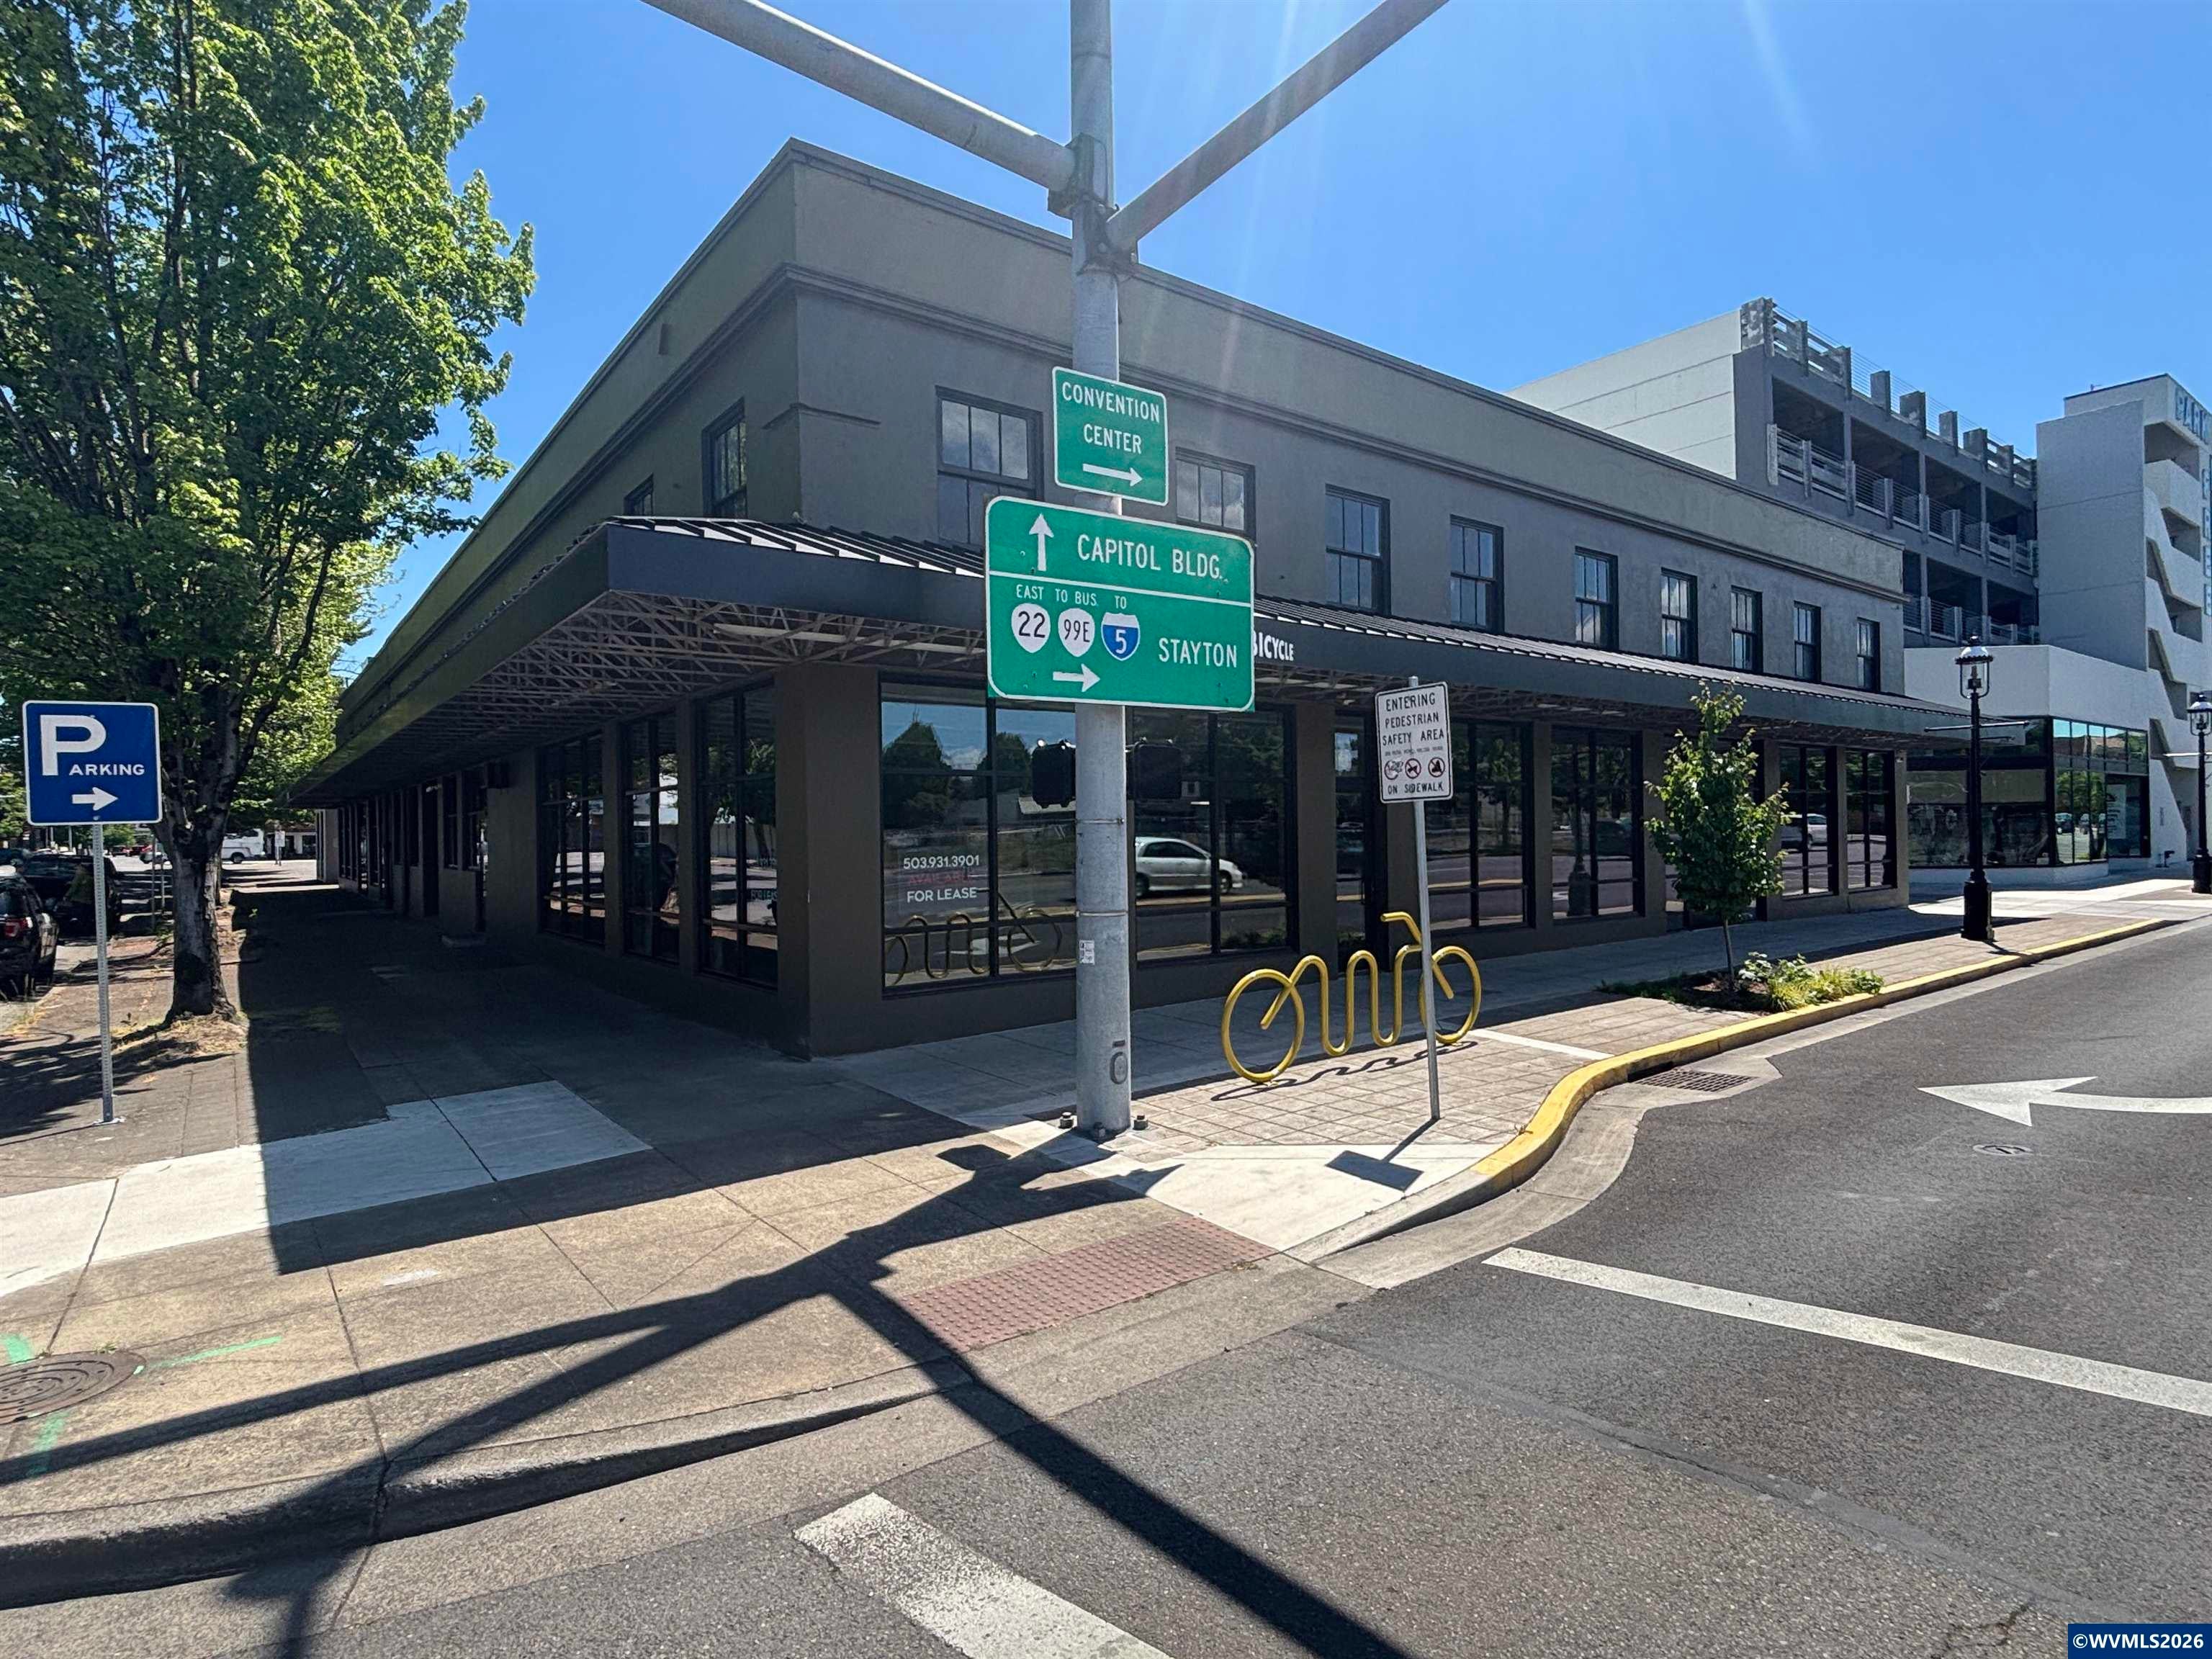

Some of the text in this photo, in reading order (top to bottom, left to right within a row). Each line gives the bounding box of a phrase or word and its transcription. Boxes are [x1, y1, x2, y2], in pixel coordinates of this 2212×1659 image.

[1062, 382, 1160, 423] CONVENTION
[1083, 423, 1142, 454] CENTER
[1077, 534, 1223, 579] CAPITOL BLDG.
[1016, 584, 1127, 609] EAST TO BUS TO
[1018, 611, 1127, 654] 22 99E 5
[1159, 637, 1237, 668] STAYTON
[1386, 693, 1435, 711] ENTERING
[1385, 711, 1439, 729] PEDESTRIAN
[1382, 729, 1444, 746] SAFETY AREA
[1388, 783, 1444, 794] ON SIDEWALK
[903, 855, 979, 869] 503.931.3901
[907, 887, 977, 903] FOR LEASE
